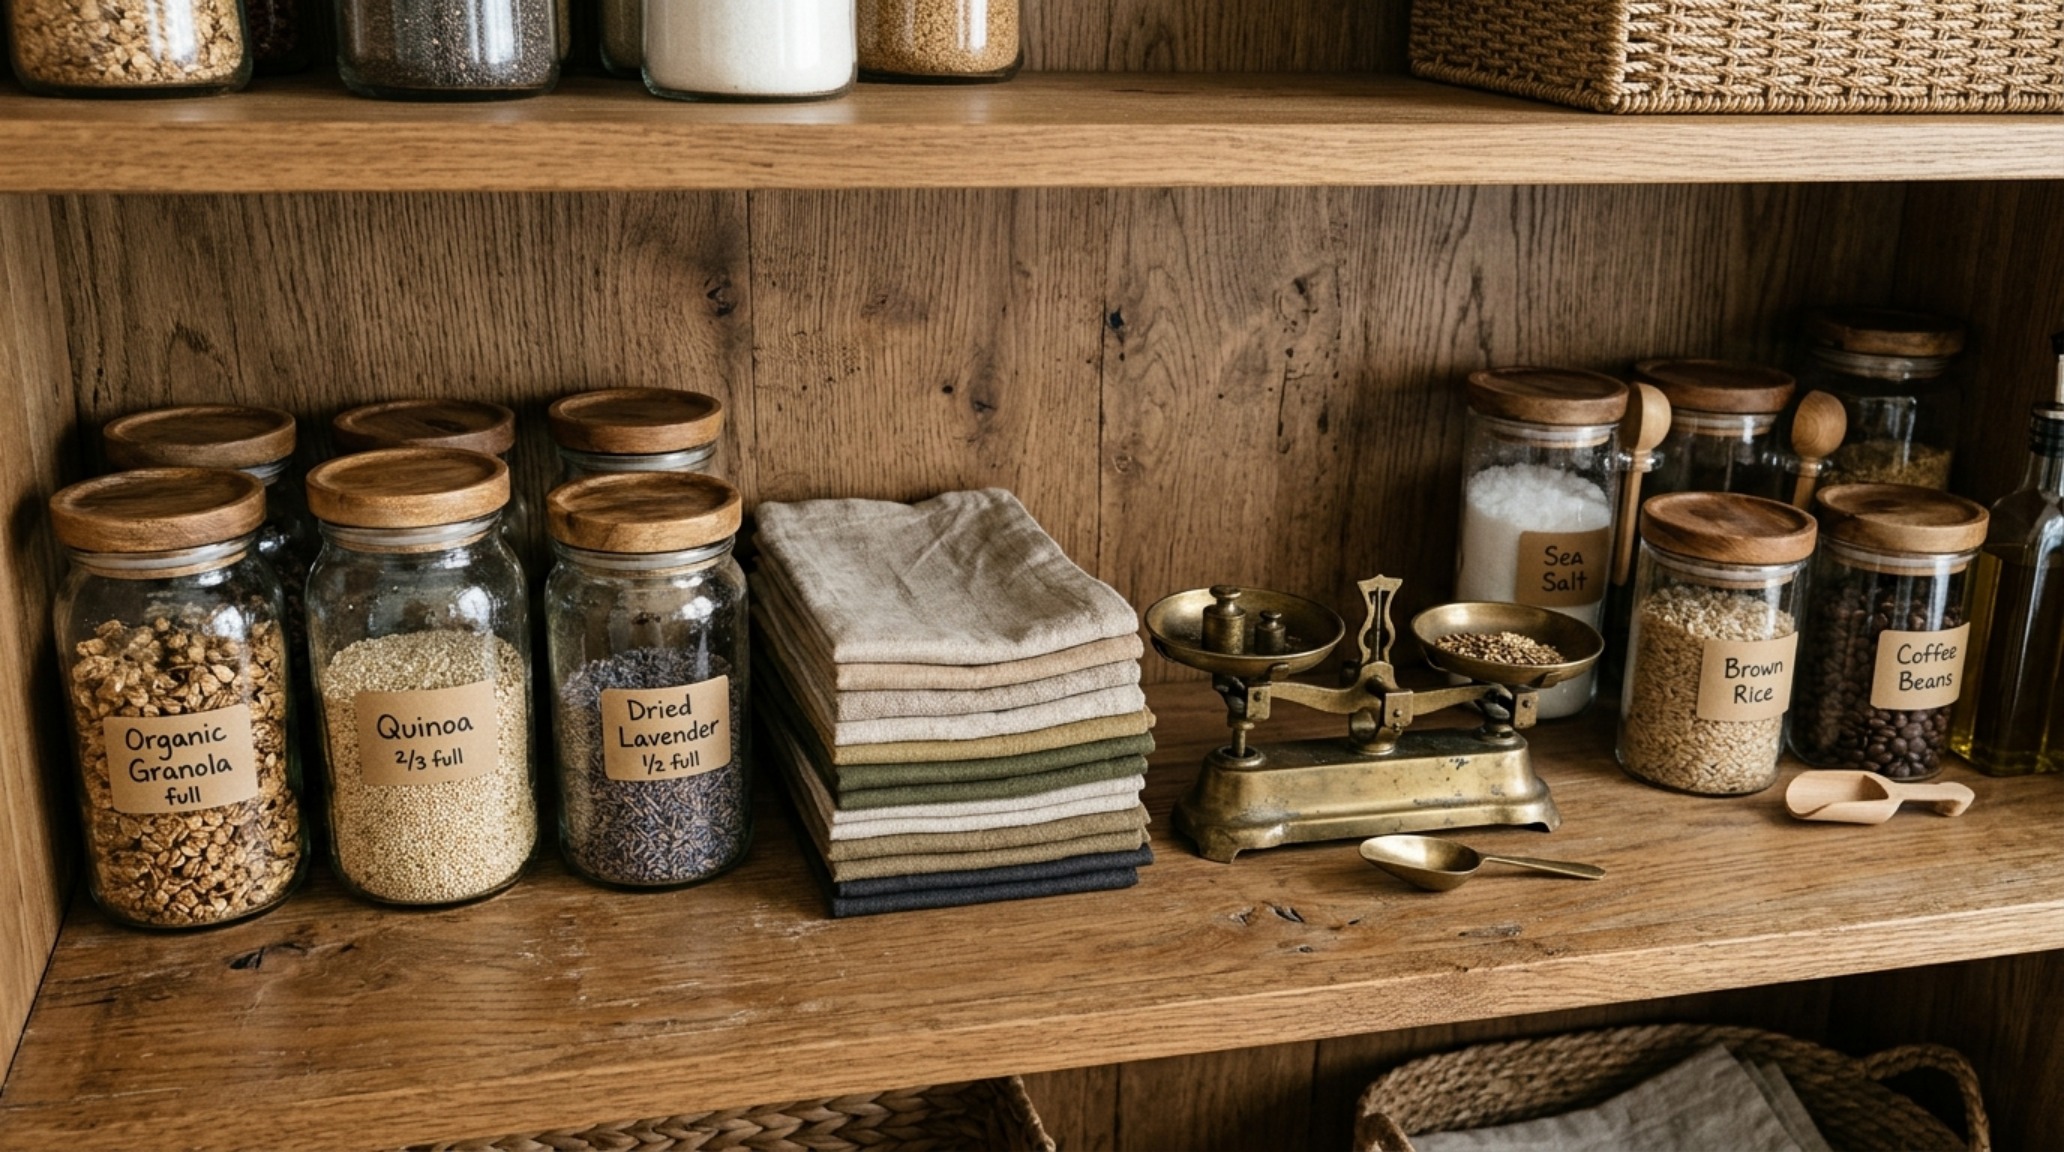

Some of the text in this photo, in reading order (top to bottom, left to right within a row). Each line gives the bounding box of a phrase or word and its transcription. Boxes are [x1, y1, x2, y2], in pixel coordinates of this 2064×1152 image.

[1541, 570, 1588, 592] Salt
[1897, 642, 1957, 665] Coffee
[1724, 657, 1783, 679] Brown
[1898, 670, 1953, 691] Beans
[1733, 684, 1774, 704] Rice
[627, 693, 692, 721] Dried
[376, 713, 474, 740] Quinoa
[619, 719, 719, 748] Lavender
[125, 723, 227, 761] Organic
[128, 753, 233, 783] Granola
[395, 747, 463, 771] 2/3 full
[642, 750, 700, 776] 1/2 full
[164, 785, 201, 806] full
